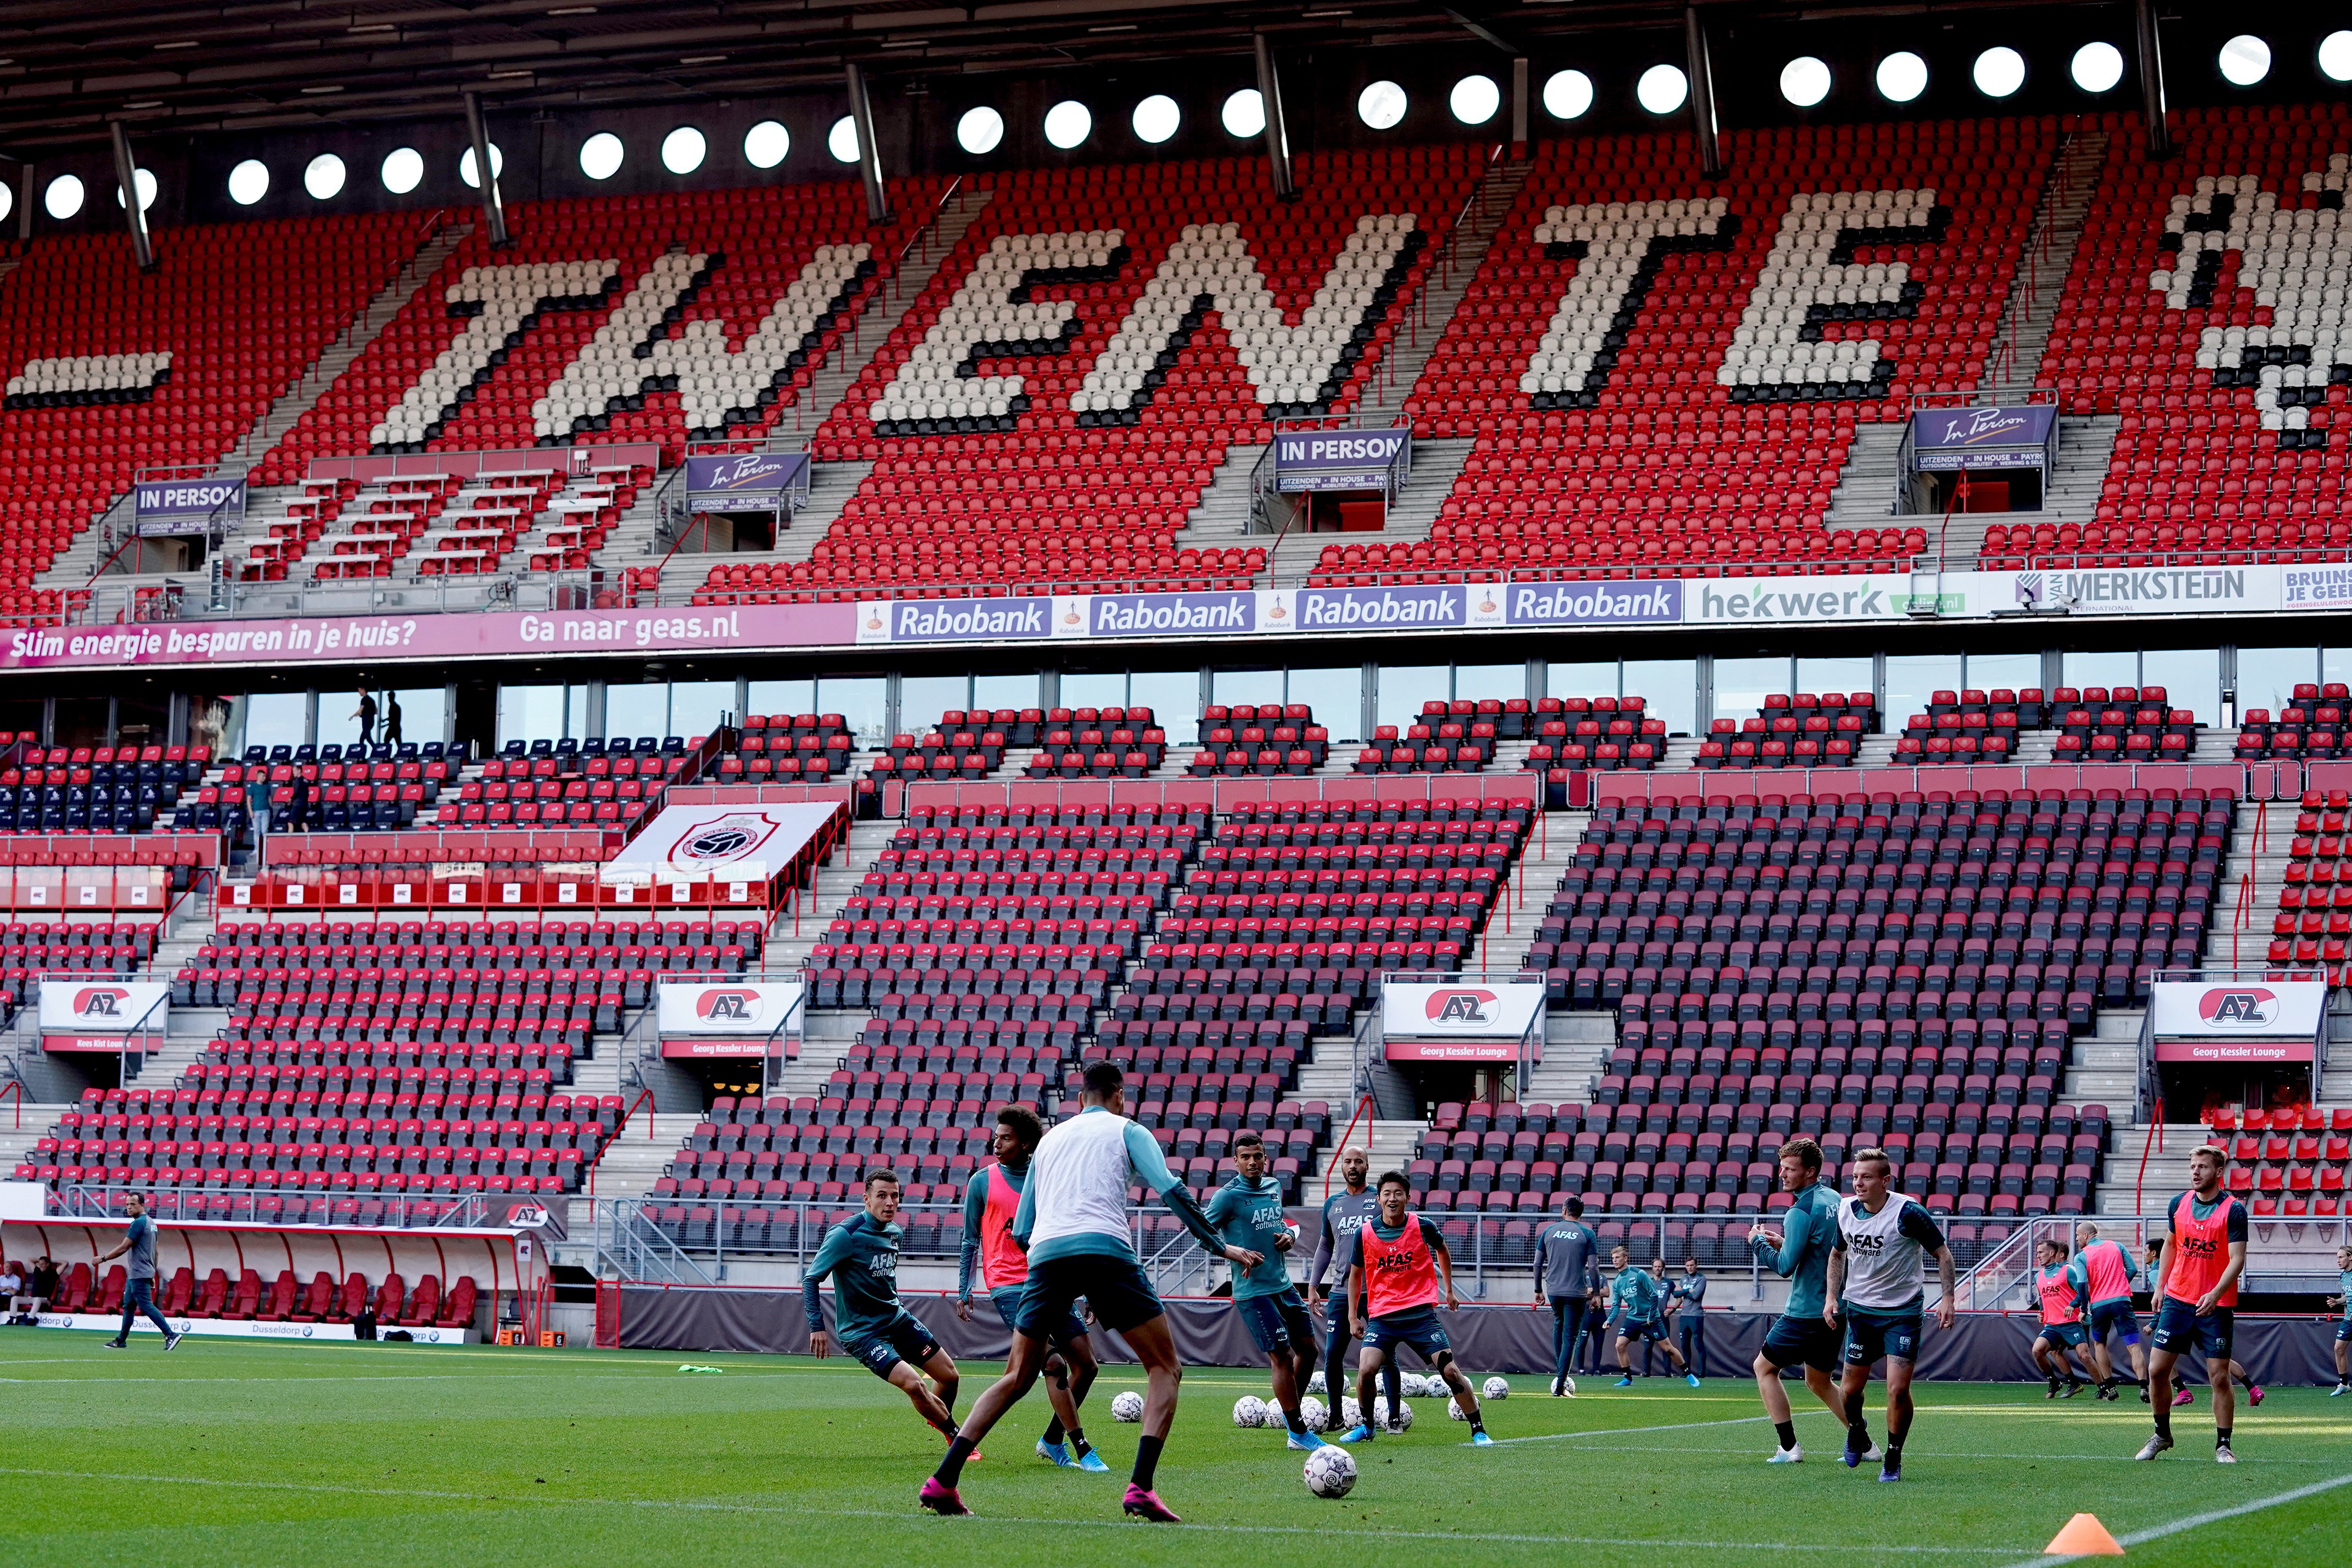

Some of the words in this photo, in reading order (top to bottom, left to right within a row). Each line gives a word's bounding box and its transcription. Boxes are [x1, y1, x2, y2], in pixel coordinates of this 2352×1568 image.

[369, 188, 1952, 456] TWENTE
[1942, 420, 1966, 444] In
[1969, 409, 2027, 435] Person
[1282, 441, 1305, 461] IN
[1312, 437, 1402, 459] PERSON
[709, 466, 731, 488] In
[733, 456, 783, 480] Person
[141, 490, 160, 509] IN
[165, 486, 239, 508] PERSON
[1703, 579, 1883, 617] hekwerk
[2050, 574, 2063, 601] VAN
[2286, 587, 2305, 601] JE
[1097, 596, 1247, 631] Rabobank
[1304, 591, 1461, 625] Rabobank
[1514, 585, 1672, 619] Rabobank
[520, 615, 554, 642] Ga
[563, 619, 628, 641] naar
[636, 610, 740, 645] geas.nl
[899, 603, 1043, 636] Rabobank
[10, 632, 64, 658] Slim
[70, 627, 161, 659] energie
[167, 627, 277, 658] besparen
[288, 623, 311, 649] in
[314, 622, 341, 655] je
[346, 619, 417, 647] huis?
[83, 992, 122, 1016] AZ
[708, 993, 752, 1020] AZ
[1438, 994, 1488, 1022] AZ
[2213, 993, 2266, 1022] AZ
[77, 1039, 92, 1047] Kees
[93, 1039, 106, 1048] Kist
[107, 1039, 131, 1048] Loune
[693, 1044, 714, 1054] Georg
[716, 1044, 742, 1053] Kessler
[743, 1044, 770, 1054] Loung
[1421, 1047, 1444, 1057] Georg
[1446, 1046, 1475, 1056] Kessler
[1477, 1047, 1507, 1058] Lounge
[2193, 1048, 2218, 1058] Georg
[2220, 1047, 2251, 1056] Kessler
[2253, 1047, 2286, 1058] Lounge
[514, 1206, 542, 1223] AZ
[1251, 1206, 1281, 1224] AFAS
[1553, 1230, 1579, 1240] AFAS
[1849, 1234, 1884, 1249] AFAS
[2182, 1237, 2218, 1252] AFAS
[1377, 1251, 1413, 1268] AFAS
[2183, 1250, 2214, 1259] software
[1381, 1264, 1411, 1274] software
[1623, 1285, 1637, 1296] AFAS
[2042, 1285, 2060, 1295] AFAS
[252, 1324, 300, 1336] Dusseldorp
